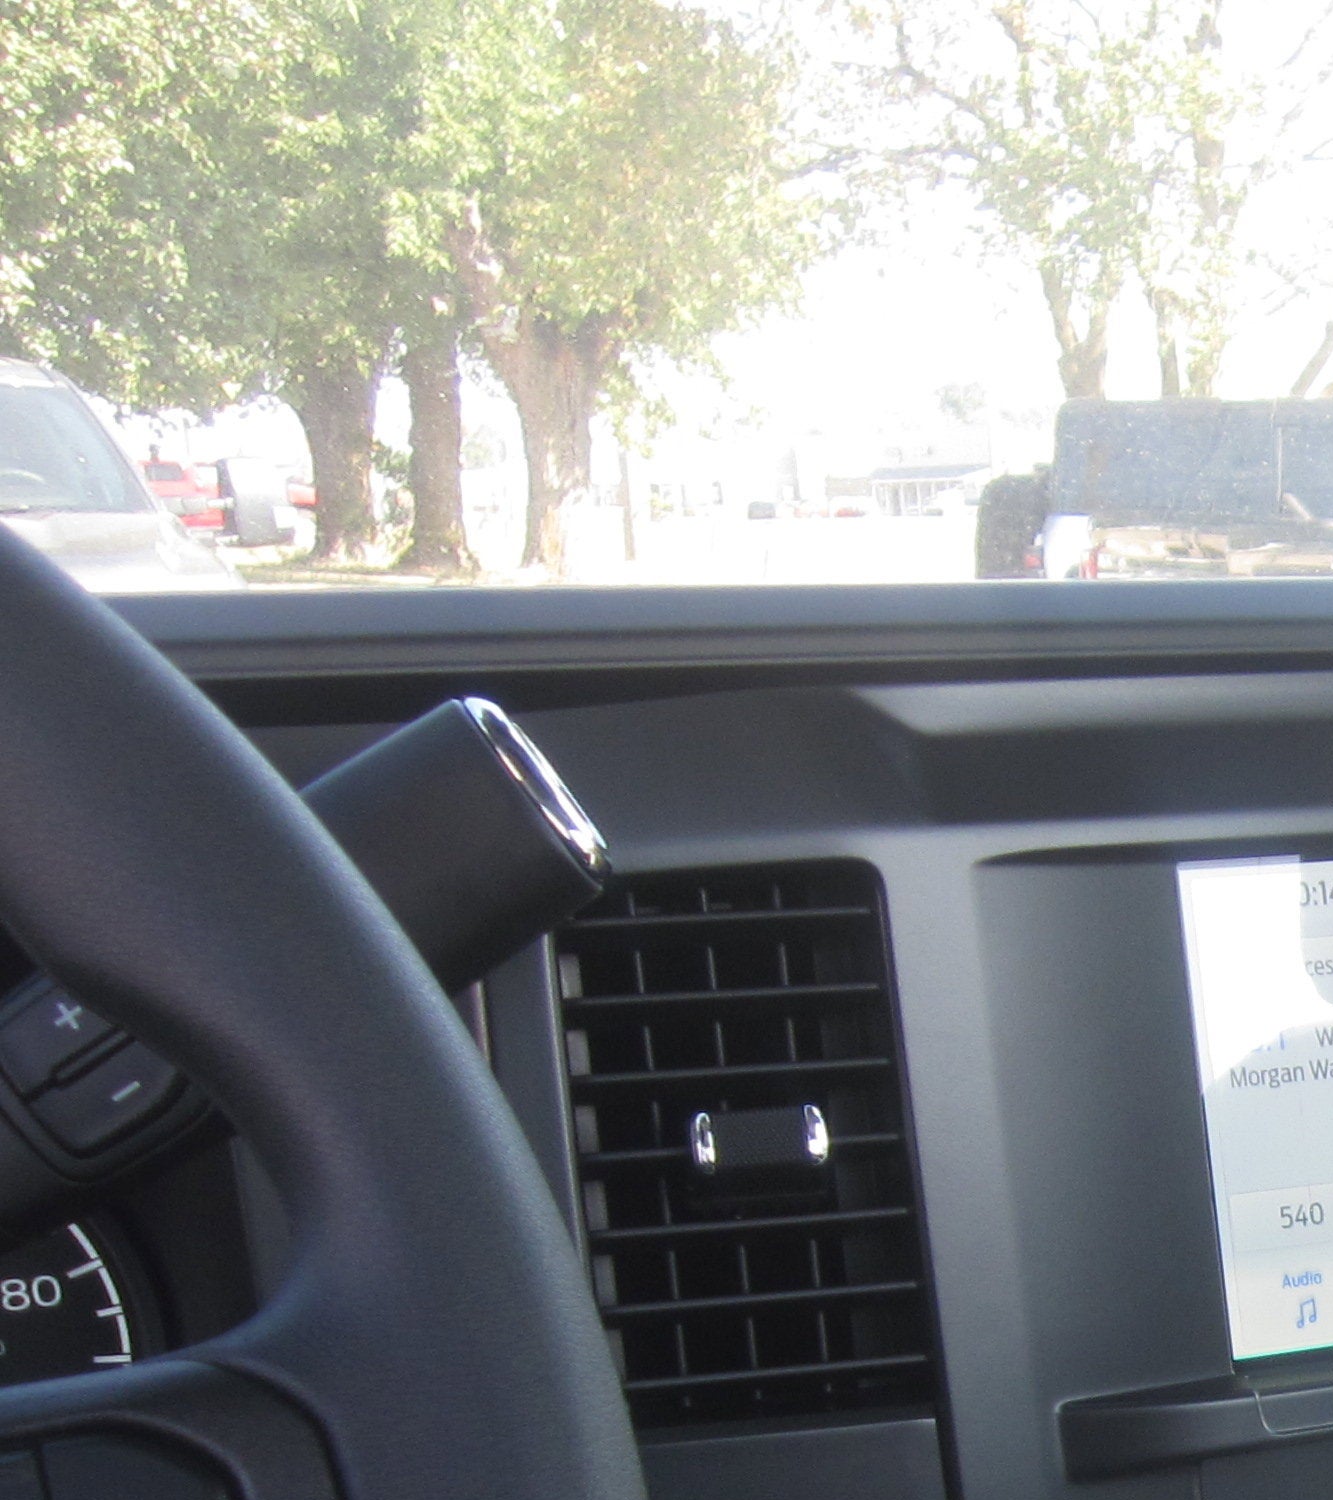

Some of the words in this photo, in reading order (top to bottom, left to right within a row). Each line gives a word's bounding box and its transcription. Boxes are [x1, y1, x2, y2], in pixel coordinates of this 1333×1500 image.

[1230, 1064, 1305, 1089] Morgan
[1279, 1202, 1325, 1230] 540
[1, 1274, 62, 1312] 80
[1282, 1271, 1323, 1290] Audio
